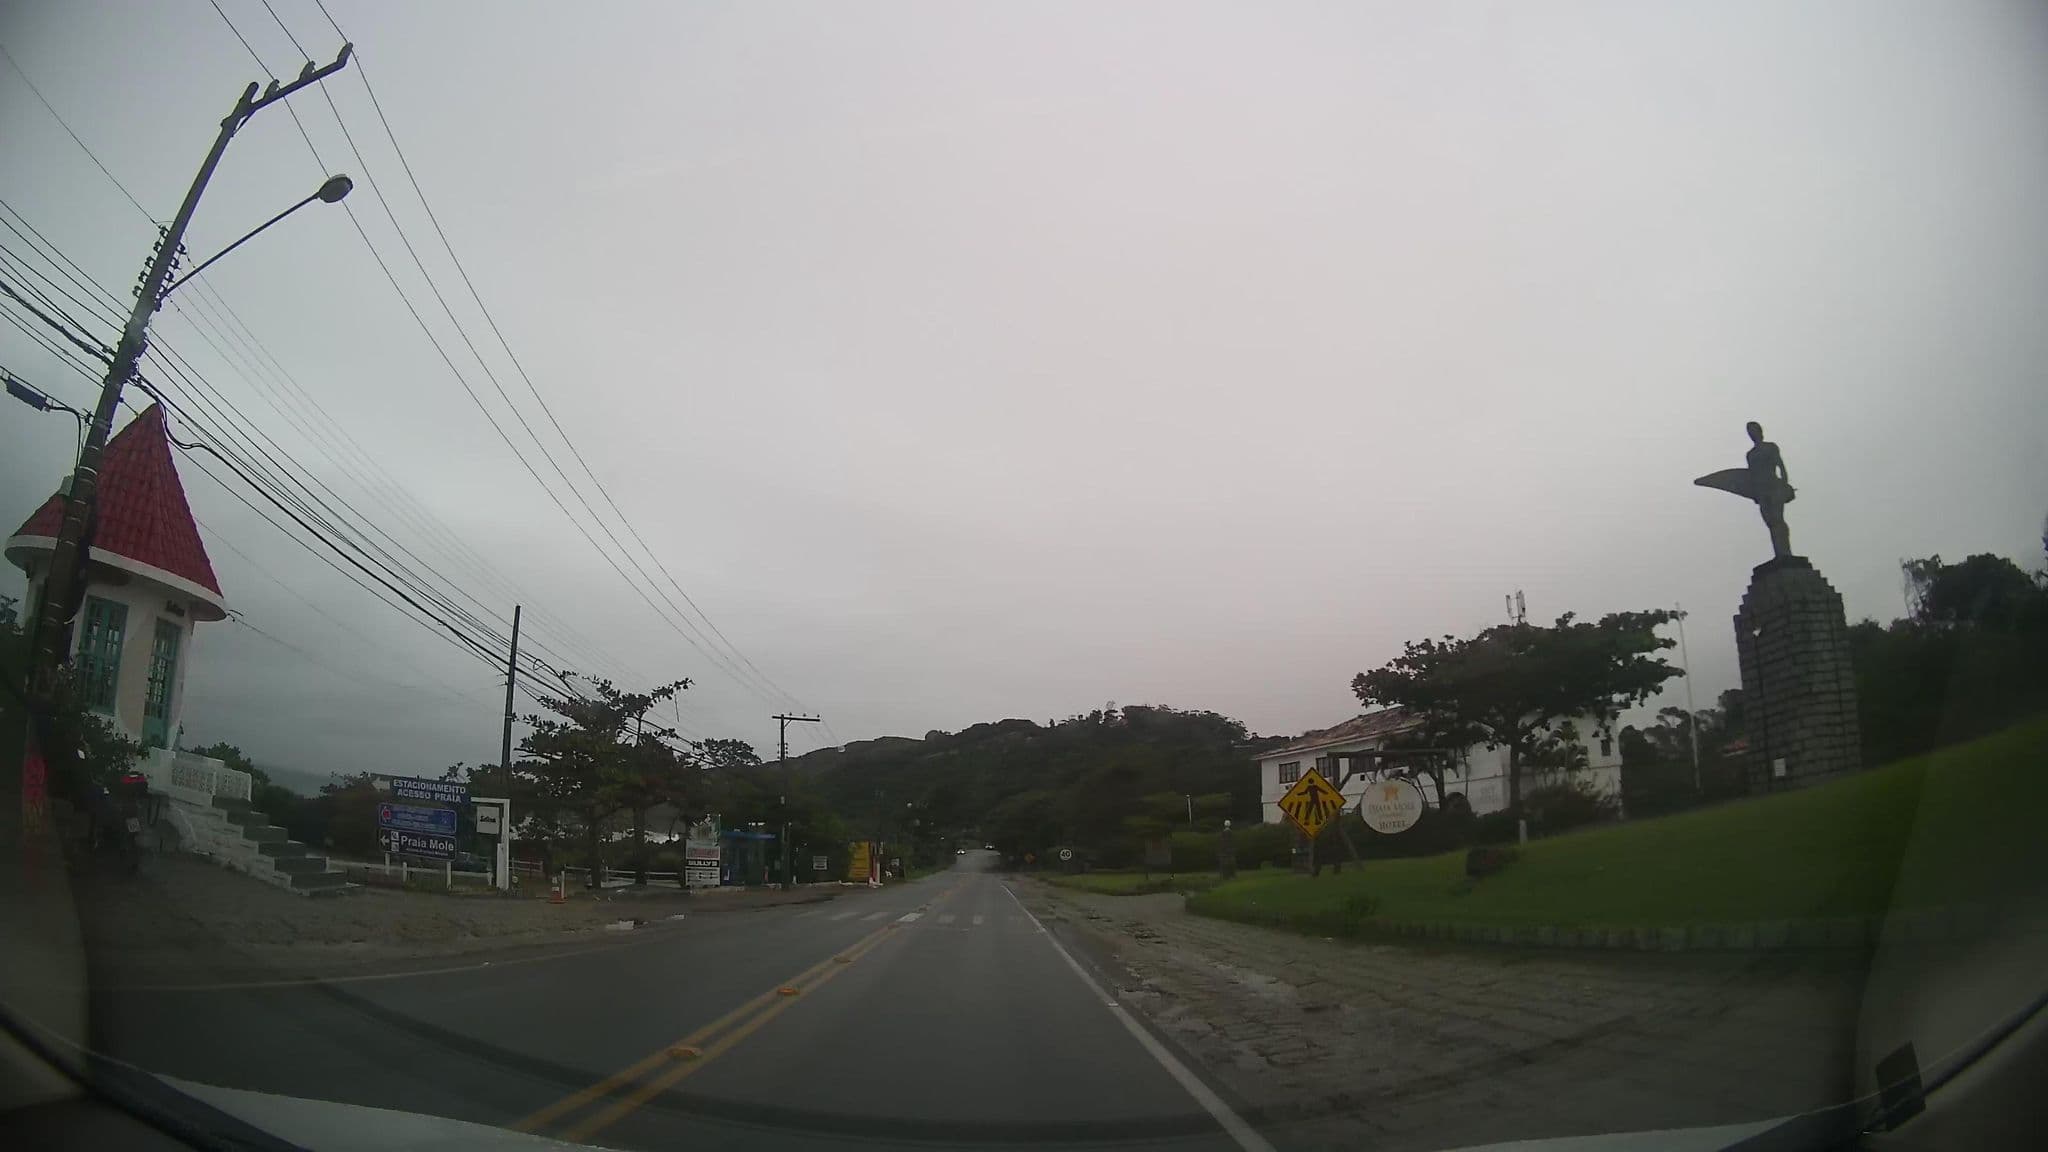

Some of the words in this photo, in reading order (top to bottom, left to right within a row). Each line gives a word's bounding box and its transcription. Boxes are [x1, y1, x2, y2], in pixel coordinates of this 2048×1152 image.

[393, 779, 466, 794] ESTACIONAMENTO
[397, 788, 431, 800] ACESSO
[434, 792, 462, 803] PRAIA
[400, 835, 427, 848] Praia
[429, 839, 454, 851] Mole
